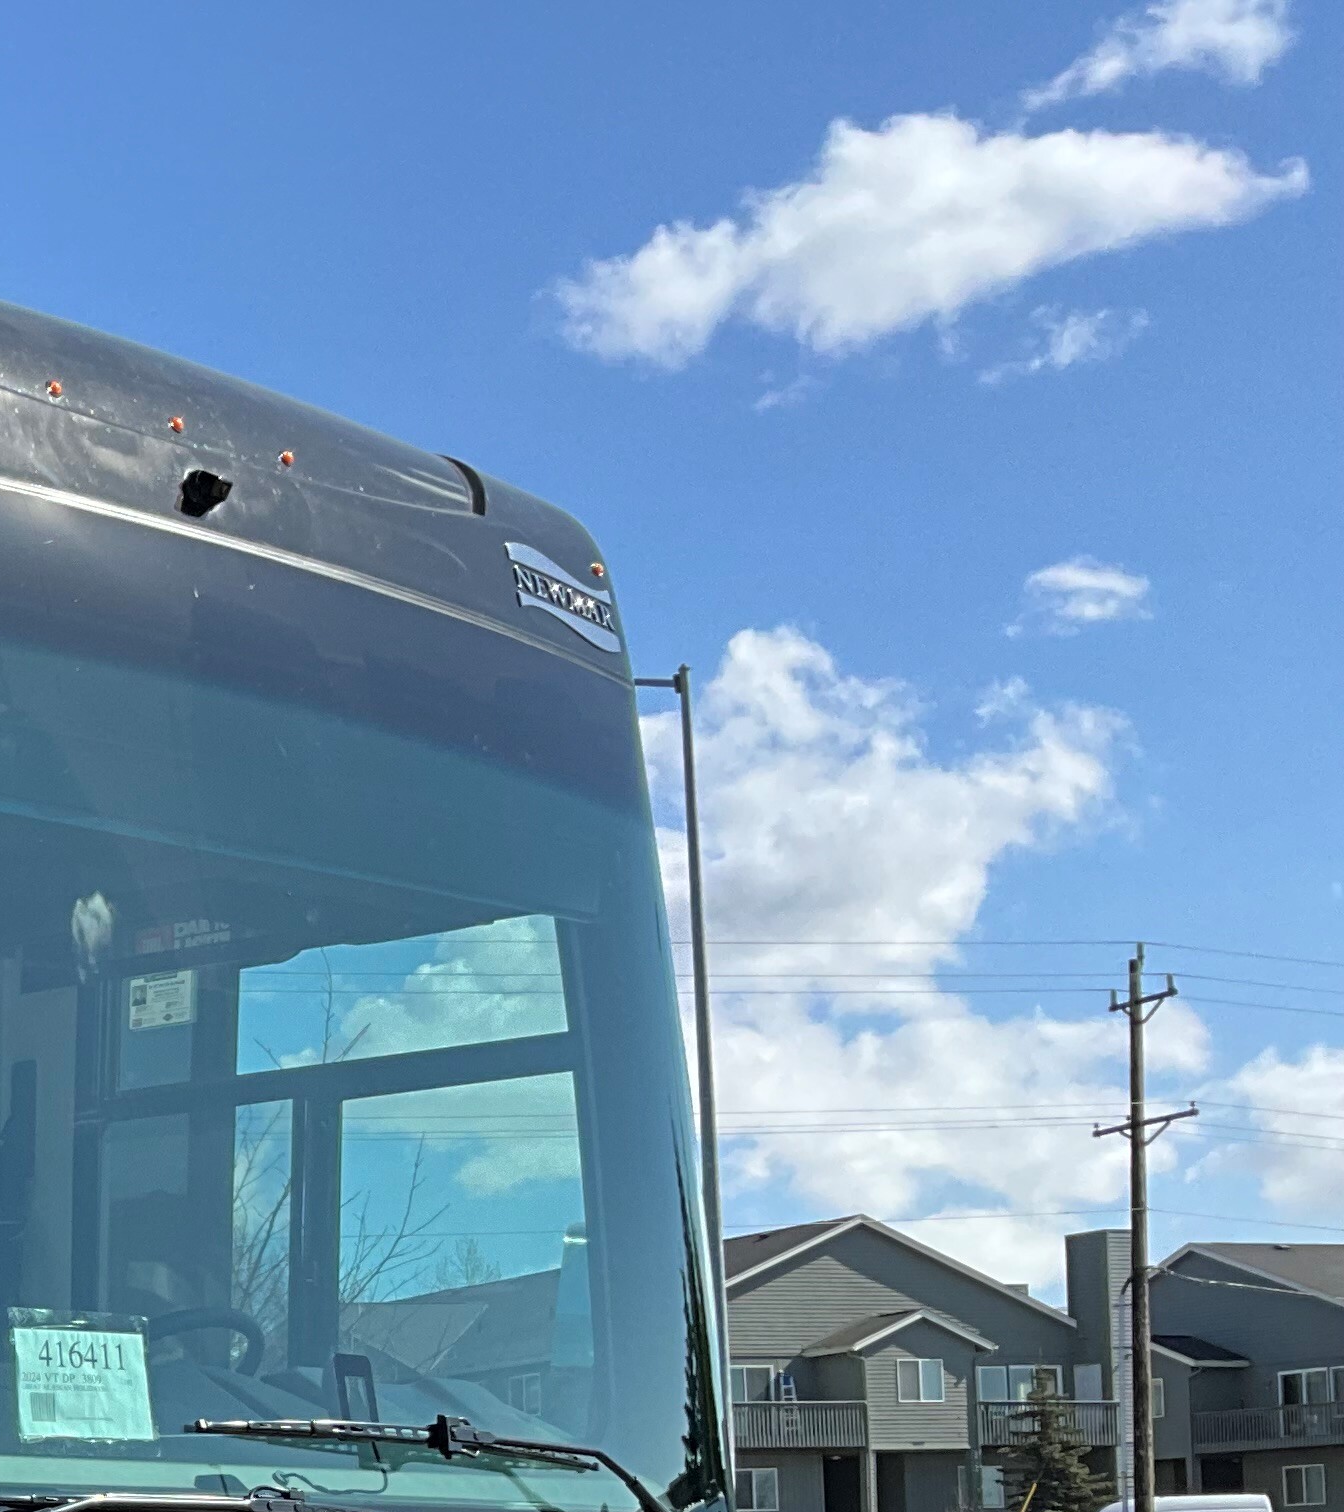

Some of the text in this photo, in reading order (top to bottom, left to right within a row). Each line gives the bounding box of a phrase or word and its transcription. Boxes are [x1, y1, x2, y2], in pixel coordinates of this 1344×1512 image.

[512, 564, 616, 632] NEWMAR
[38, 1339, 126, 1371] 416411
[22, 1372, 41, 1382] 2024
[44, 1372, 59, 1382] VT
[62, 1373, 76, 1383] DP
